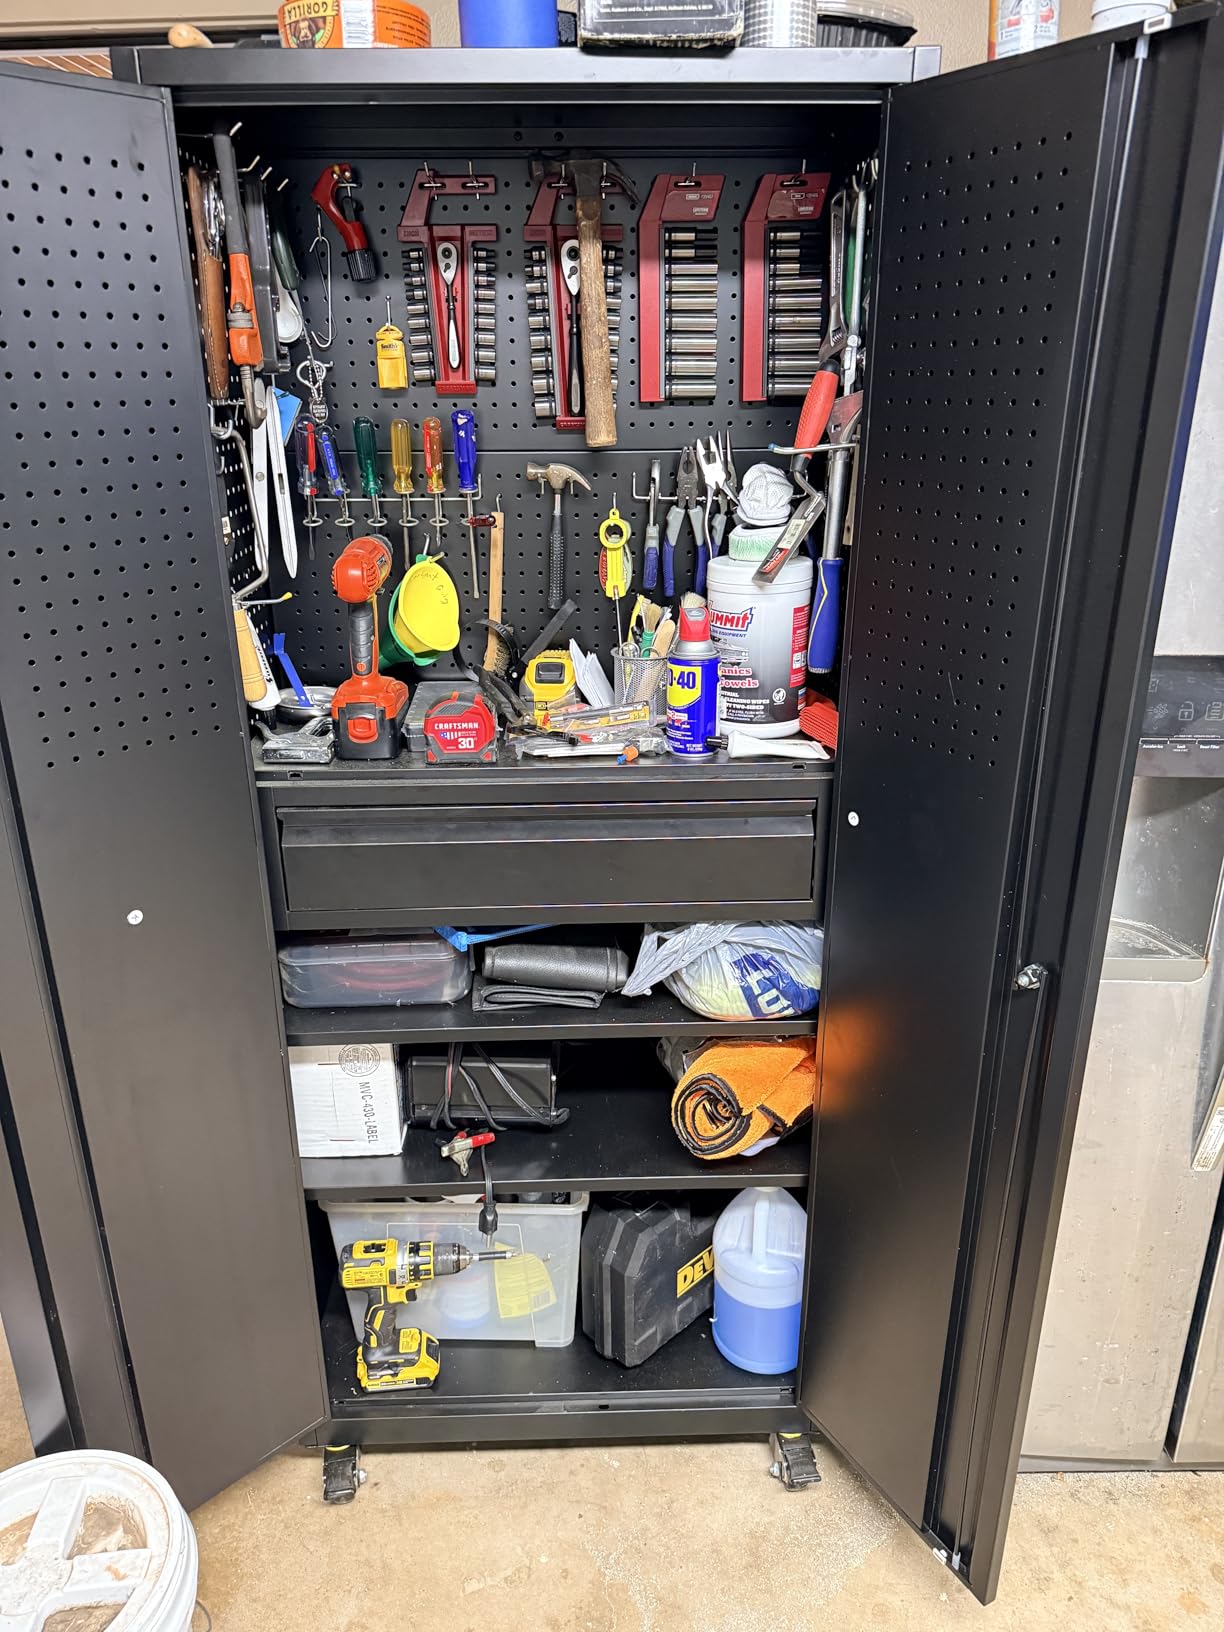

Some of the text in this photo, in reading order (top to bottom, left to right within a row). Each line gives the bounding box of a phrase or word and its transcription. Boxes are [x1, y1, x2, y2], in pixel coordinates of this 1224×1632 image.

[286, 0, 328, 20] GORILLA
[710, 611, 749, 628] UMMIT
[719, 630, 747, 638] EQUIPMENT
[721, 667, 751, 675] anics
[434, 722, 479, 730] CRAFTSMAN
[458, 737, 475, 749] 30
[358, 1081, 379, 1144] MVC-430-LABEL
